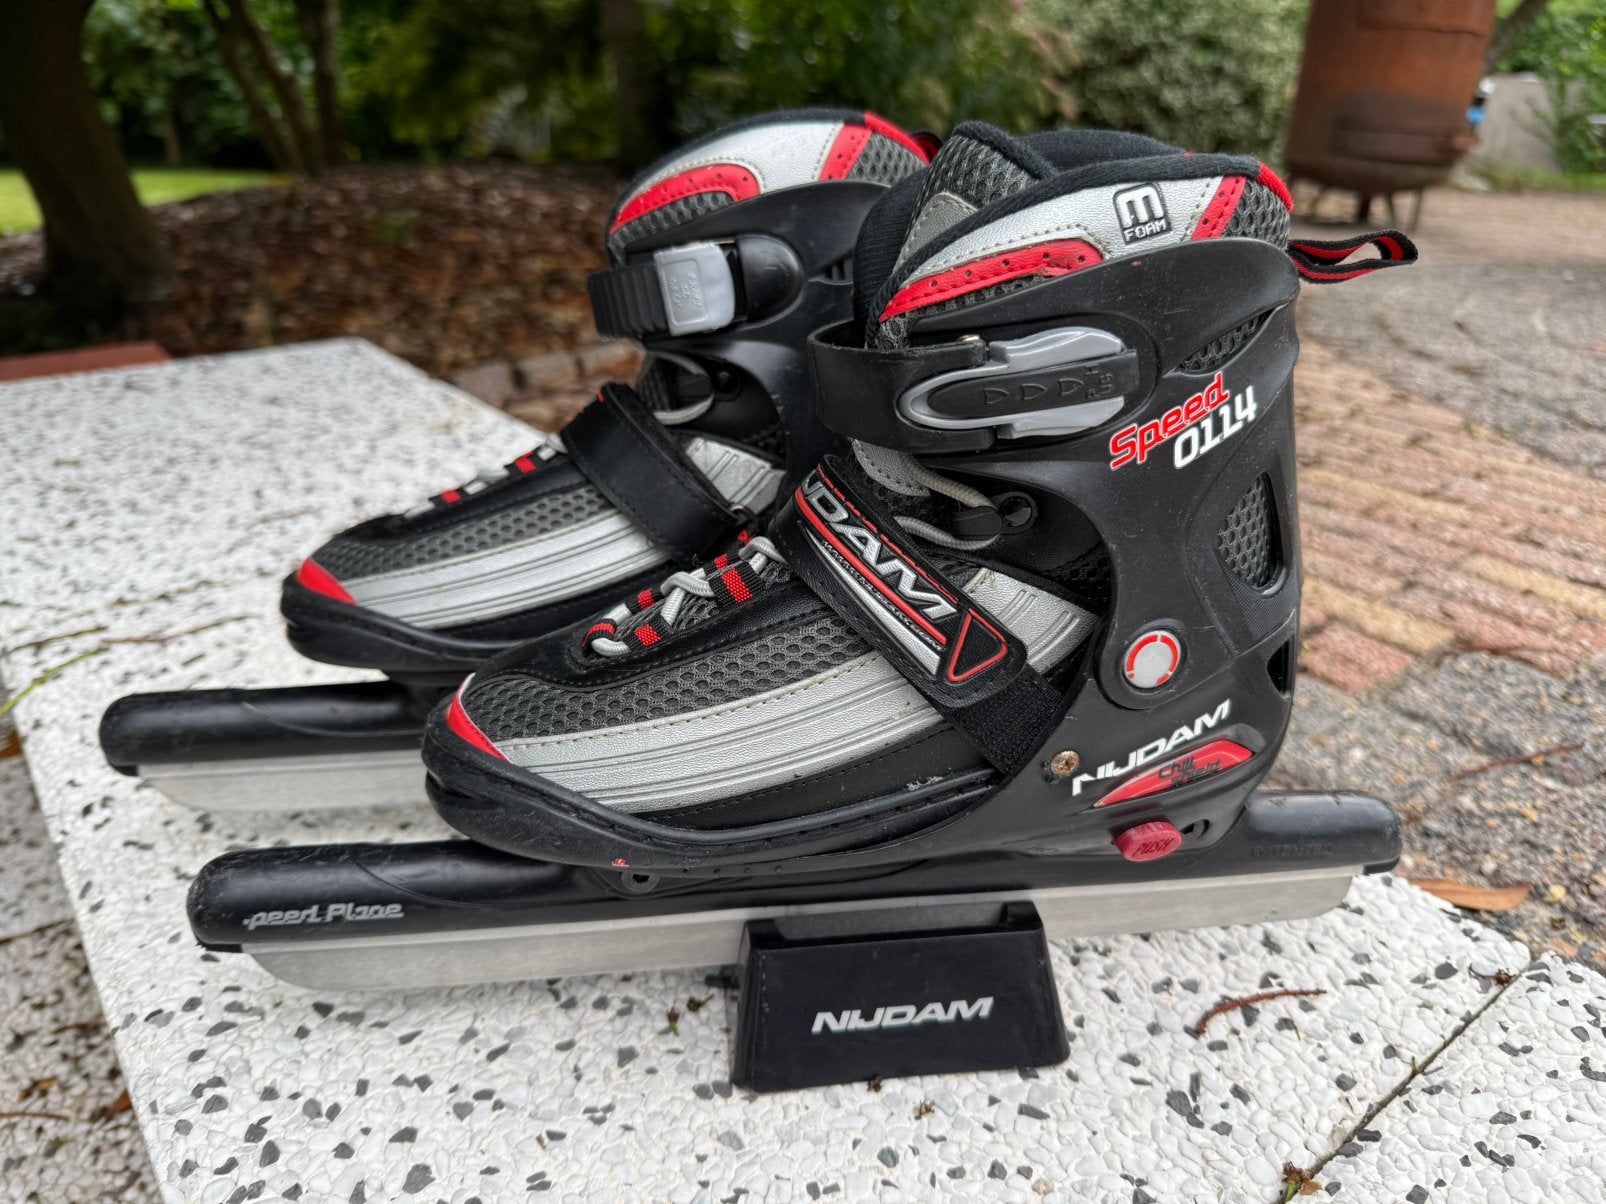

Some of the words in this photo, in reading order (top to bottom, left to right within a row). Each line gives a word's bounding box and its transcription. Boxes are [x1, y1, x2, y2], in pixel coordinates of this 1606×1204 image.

[1123, 218, 1167, 242] FOAM
[1109, 370, 1230, 471] Speed
[1071, 698, 1231, 797] NIJDAM
[1131, 837, 1175, 858] PUSH
[242, 904, 322, 931] peed
[811, 996, 994, 1034] NIJDAM
